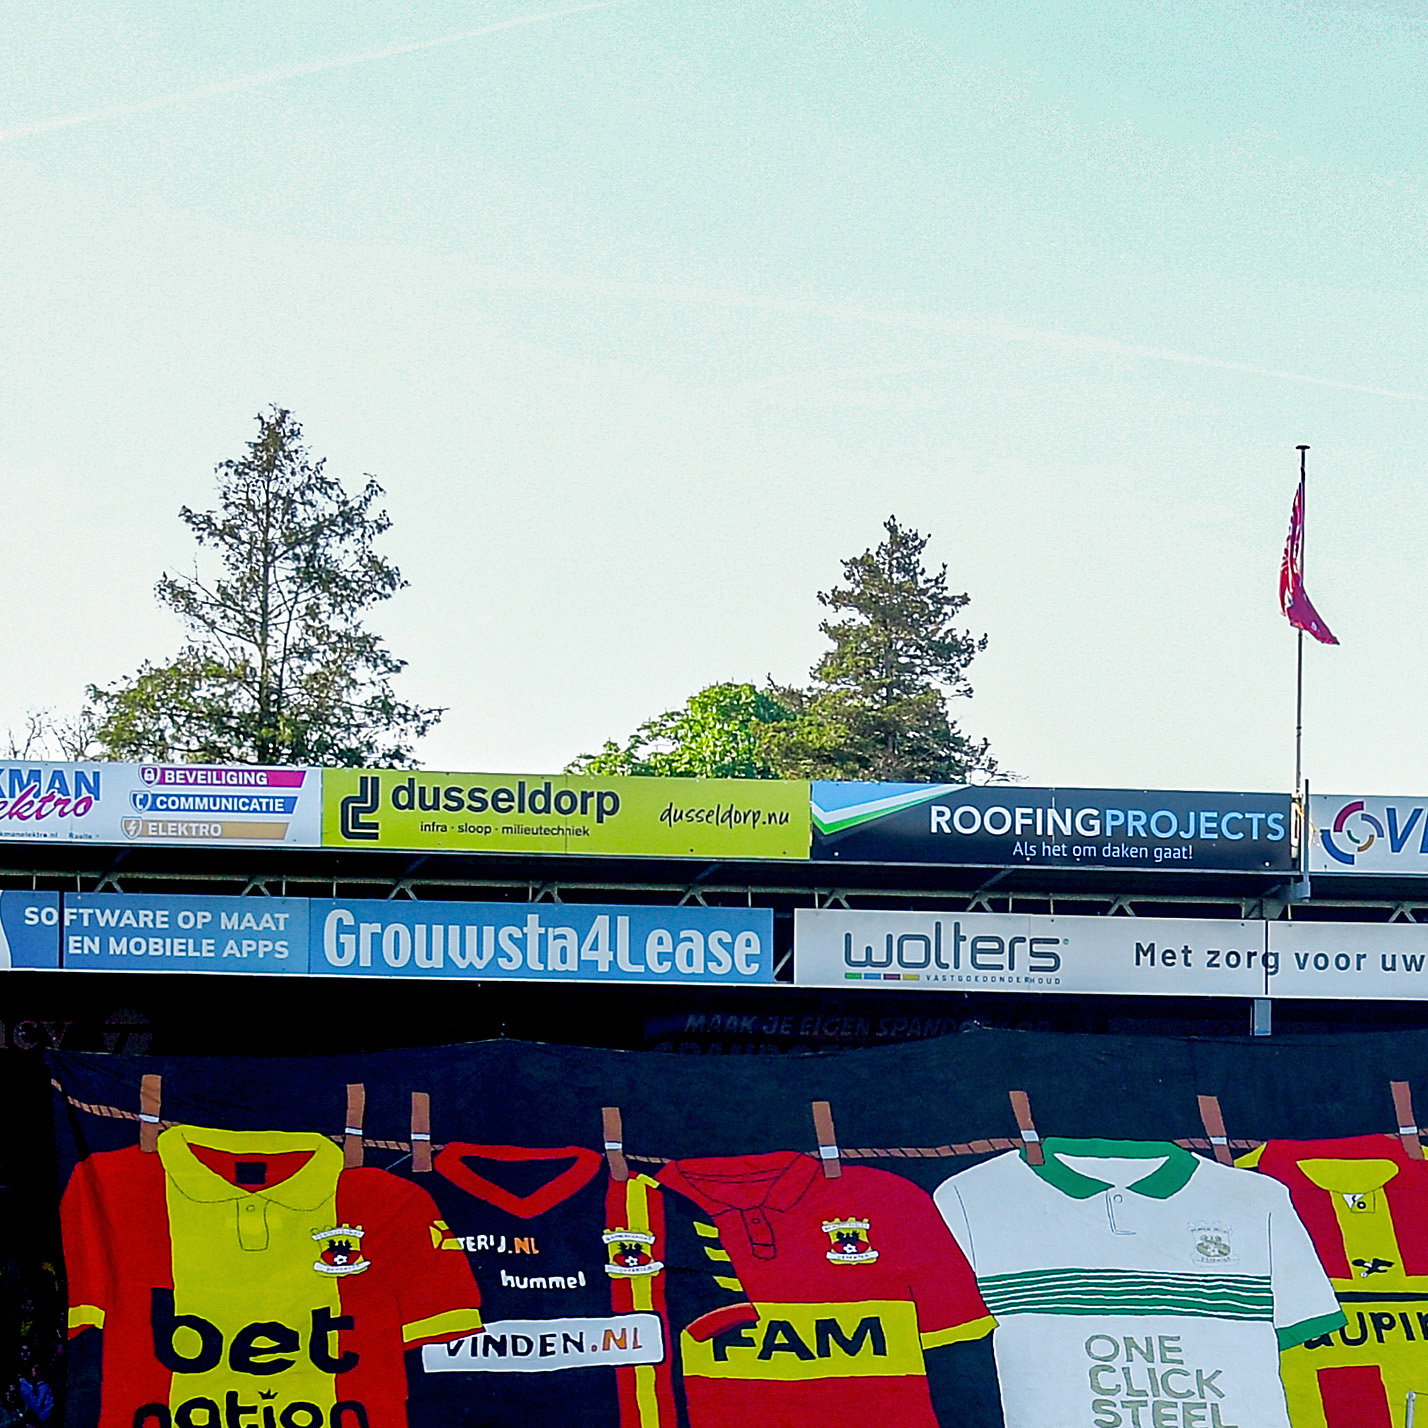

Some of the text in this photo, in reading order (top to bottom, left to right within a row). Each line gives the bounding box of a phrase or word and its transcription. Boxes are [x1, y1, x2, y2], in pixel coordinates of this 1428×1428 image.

[0, 768, 100, 801] MAN
[164, 769, 268, 786] BEVEILIGING
[156, 796, 284, 812] COMMUNICATIE
[391, 777, 620, 823] dusseldorp
[659, 802, 790, 828] dusseldorp.nu
[148, 822, 222, 837] ELEKTRO
[420, 820, 590, 837] infra sloop milieutechniek
[930, 805, 1285, 842] ROOFINGPROJECTS
[1013, 841, 1194, 863] Als het om daken gaat!
[24, 907, 289, 932] SOFTWARE OP MAAT
[68, 936, 289, 959] EN MOBIELE APPS
[323, 908, 760, 975] Grouwsta4Lease
[844, 920, 1061, 972] wolters
[1135, 942, 1192, 968] Met
[1206, 947, 1280, 975] zorg
[1294, 952, 1367, 972] voor
[1380, 953, 1426, 973] uw
[500, 1269, 586, 1289] hummel
[151, 1287, 359, 1375] bet
[713, 1317, 888, 1361] FAM
[1085, 1334, 1184, 1366] ONE
[1089, 1365, 1225, 1399] CLICK
